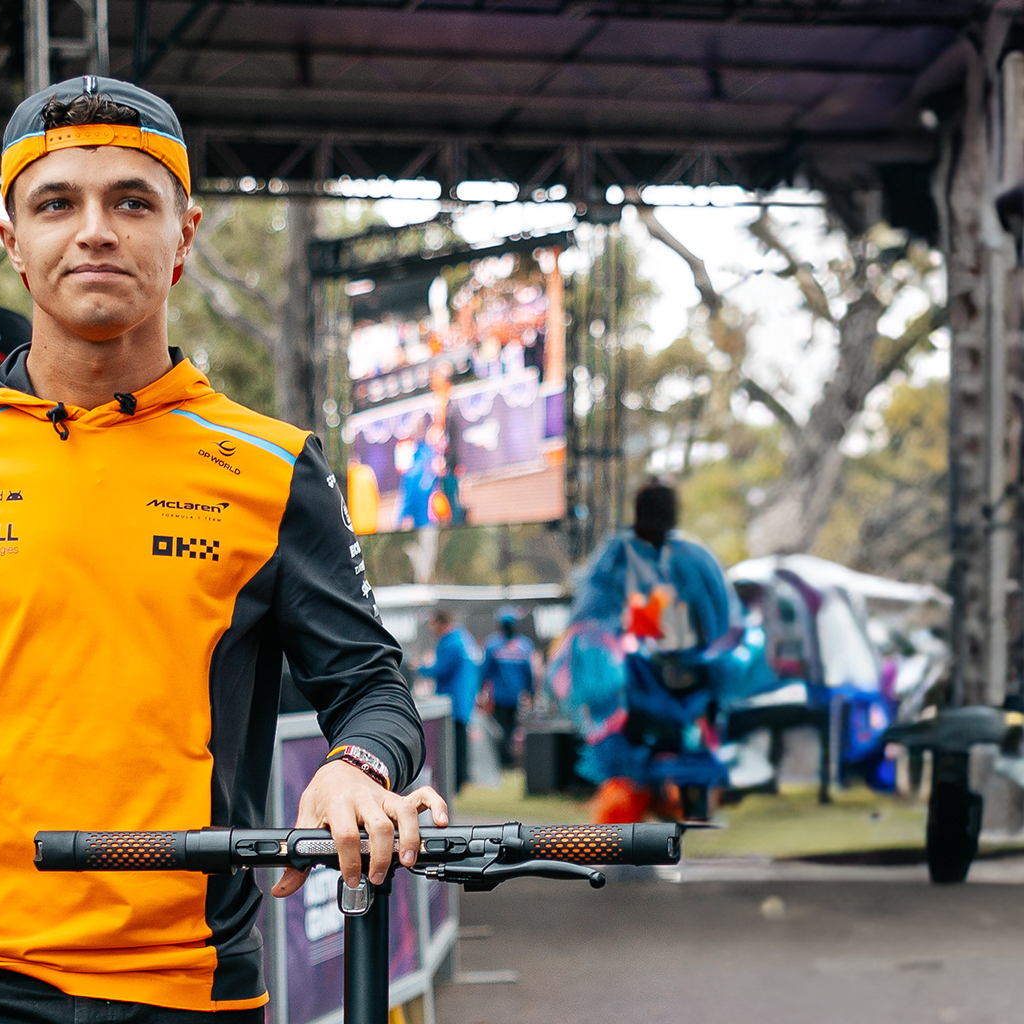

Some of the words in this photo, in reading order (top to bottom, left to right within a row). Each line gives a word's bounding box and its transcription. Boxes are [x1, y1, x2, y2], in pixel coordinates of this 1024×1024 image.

[198, 449, 210, 458] DP
[211, 455, 241, 475] WORLD
[146, 499, 222, 513] McLaren
[152, 535, 220, 561] OKX
